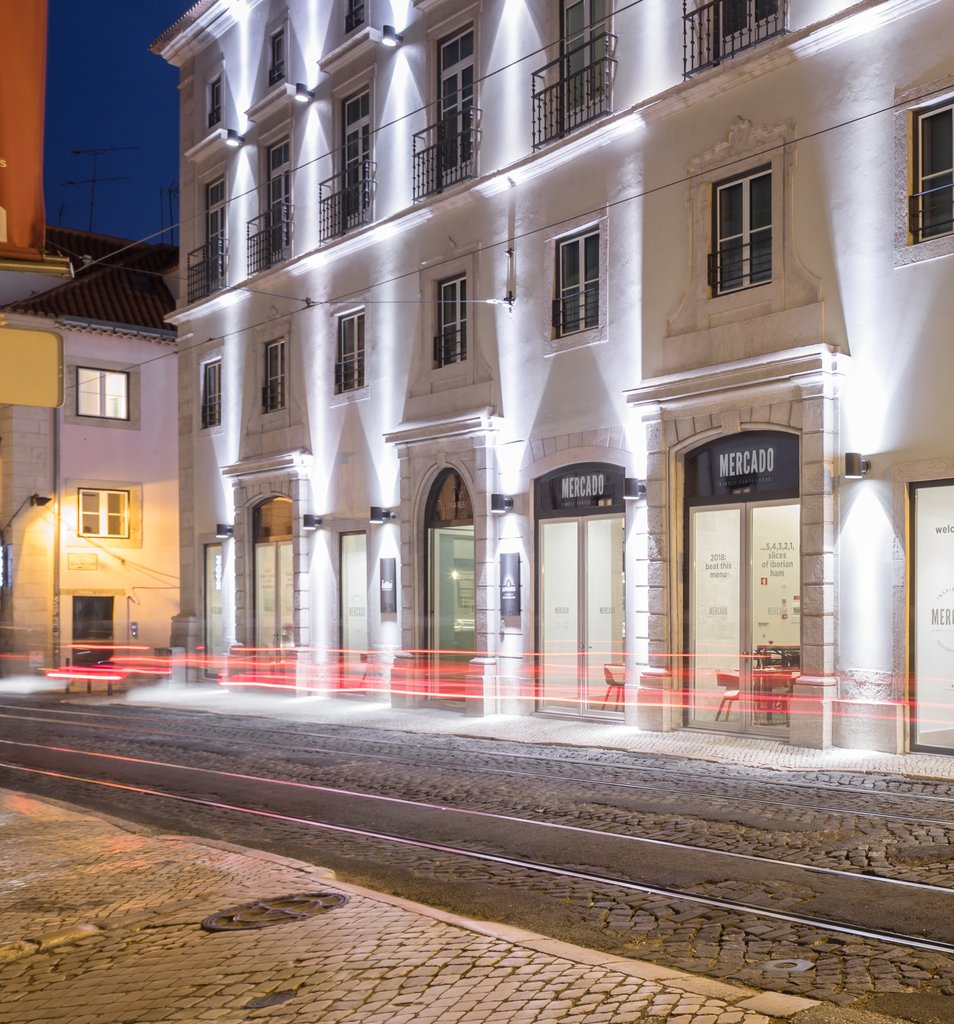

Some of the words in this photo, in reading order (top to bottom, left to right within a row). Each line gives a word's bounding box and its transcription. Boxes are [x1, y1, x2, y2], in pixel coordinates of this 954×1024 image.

[720, 448, 774, 477] MERCADO
[562, 474, 604, 498] MERCADO
[705, 562, 719, 570] beat
[720, 561, 732, 569] this
[710, 554, 727, 562] 2018:
